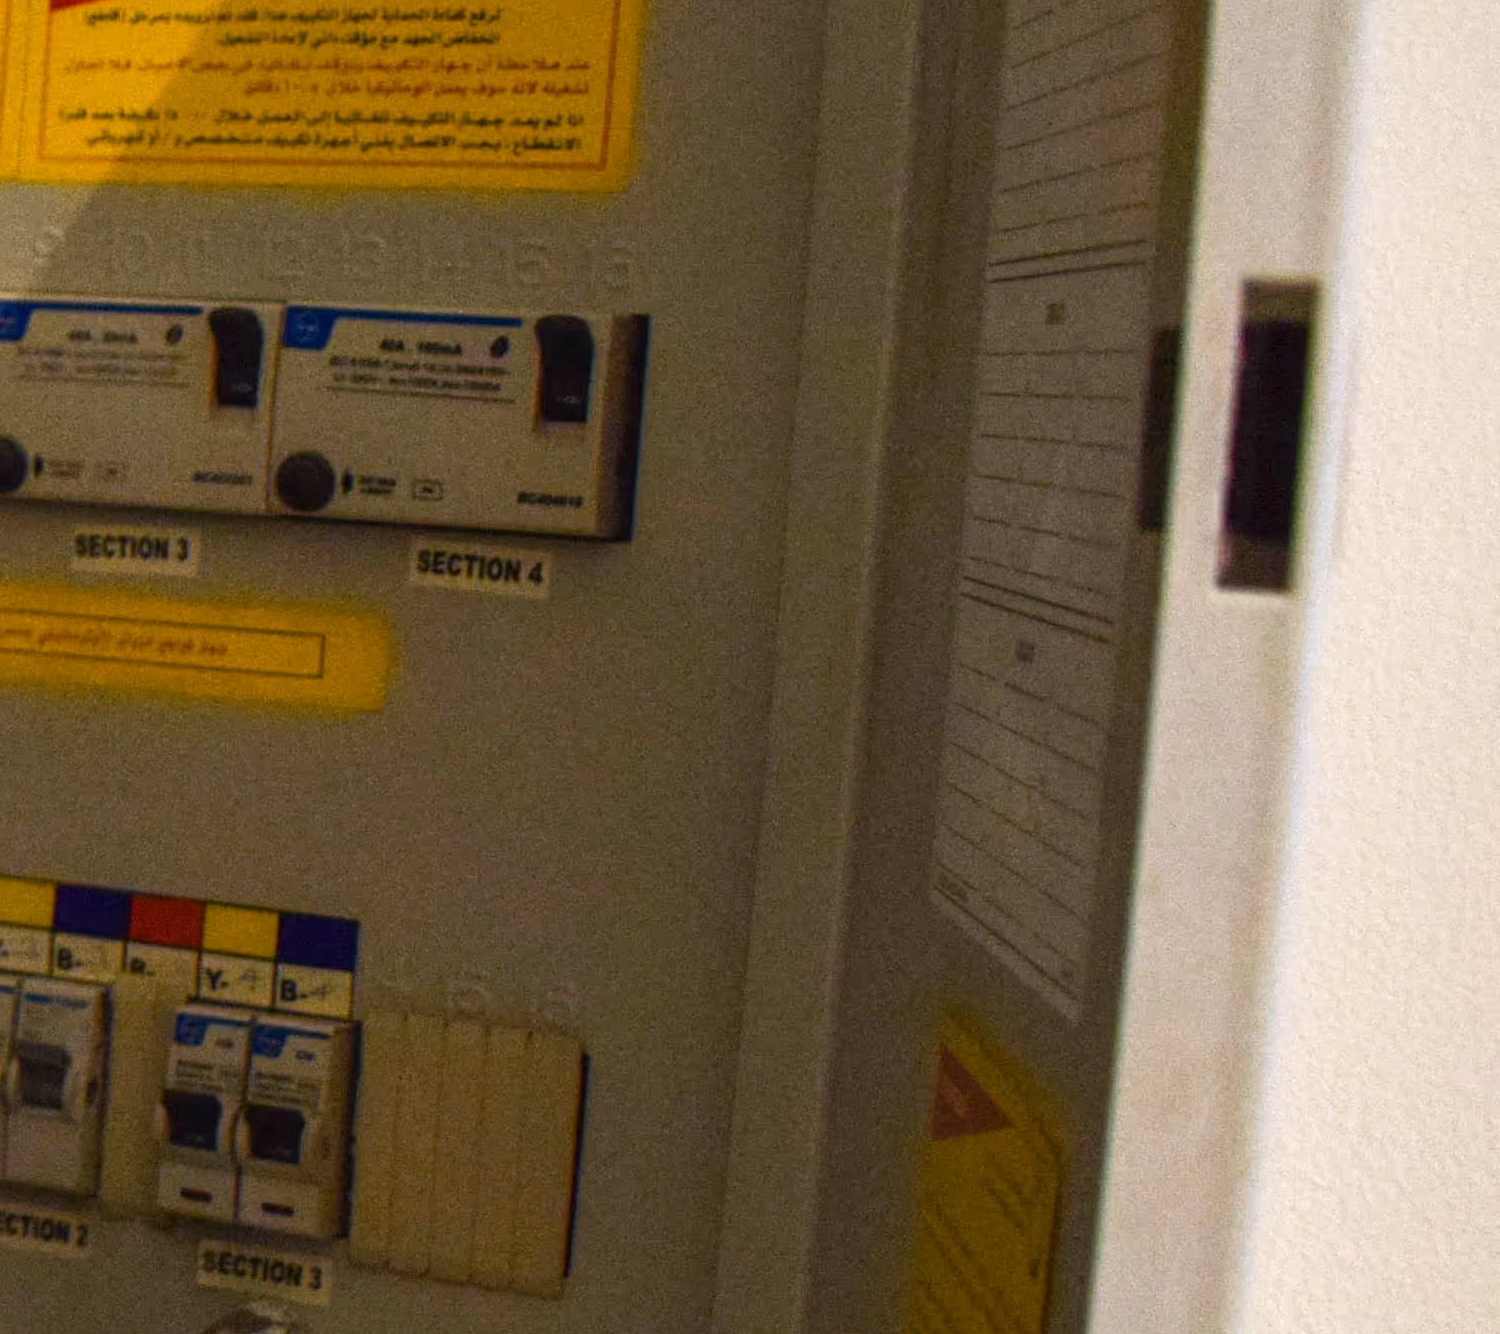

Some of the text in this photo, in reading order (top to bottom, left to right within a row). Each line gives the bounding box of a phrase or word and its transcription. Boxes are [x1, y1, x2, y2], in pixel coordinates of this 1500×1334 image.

[74, 533, 190, 562] SECTION 3
[416, 549, 545, 585] SECTION 4
[75, 1223, 89, 1248] 2
[201, 1248, 323, 1290] SECTION 3
